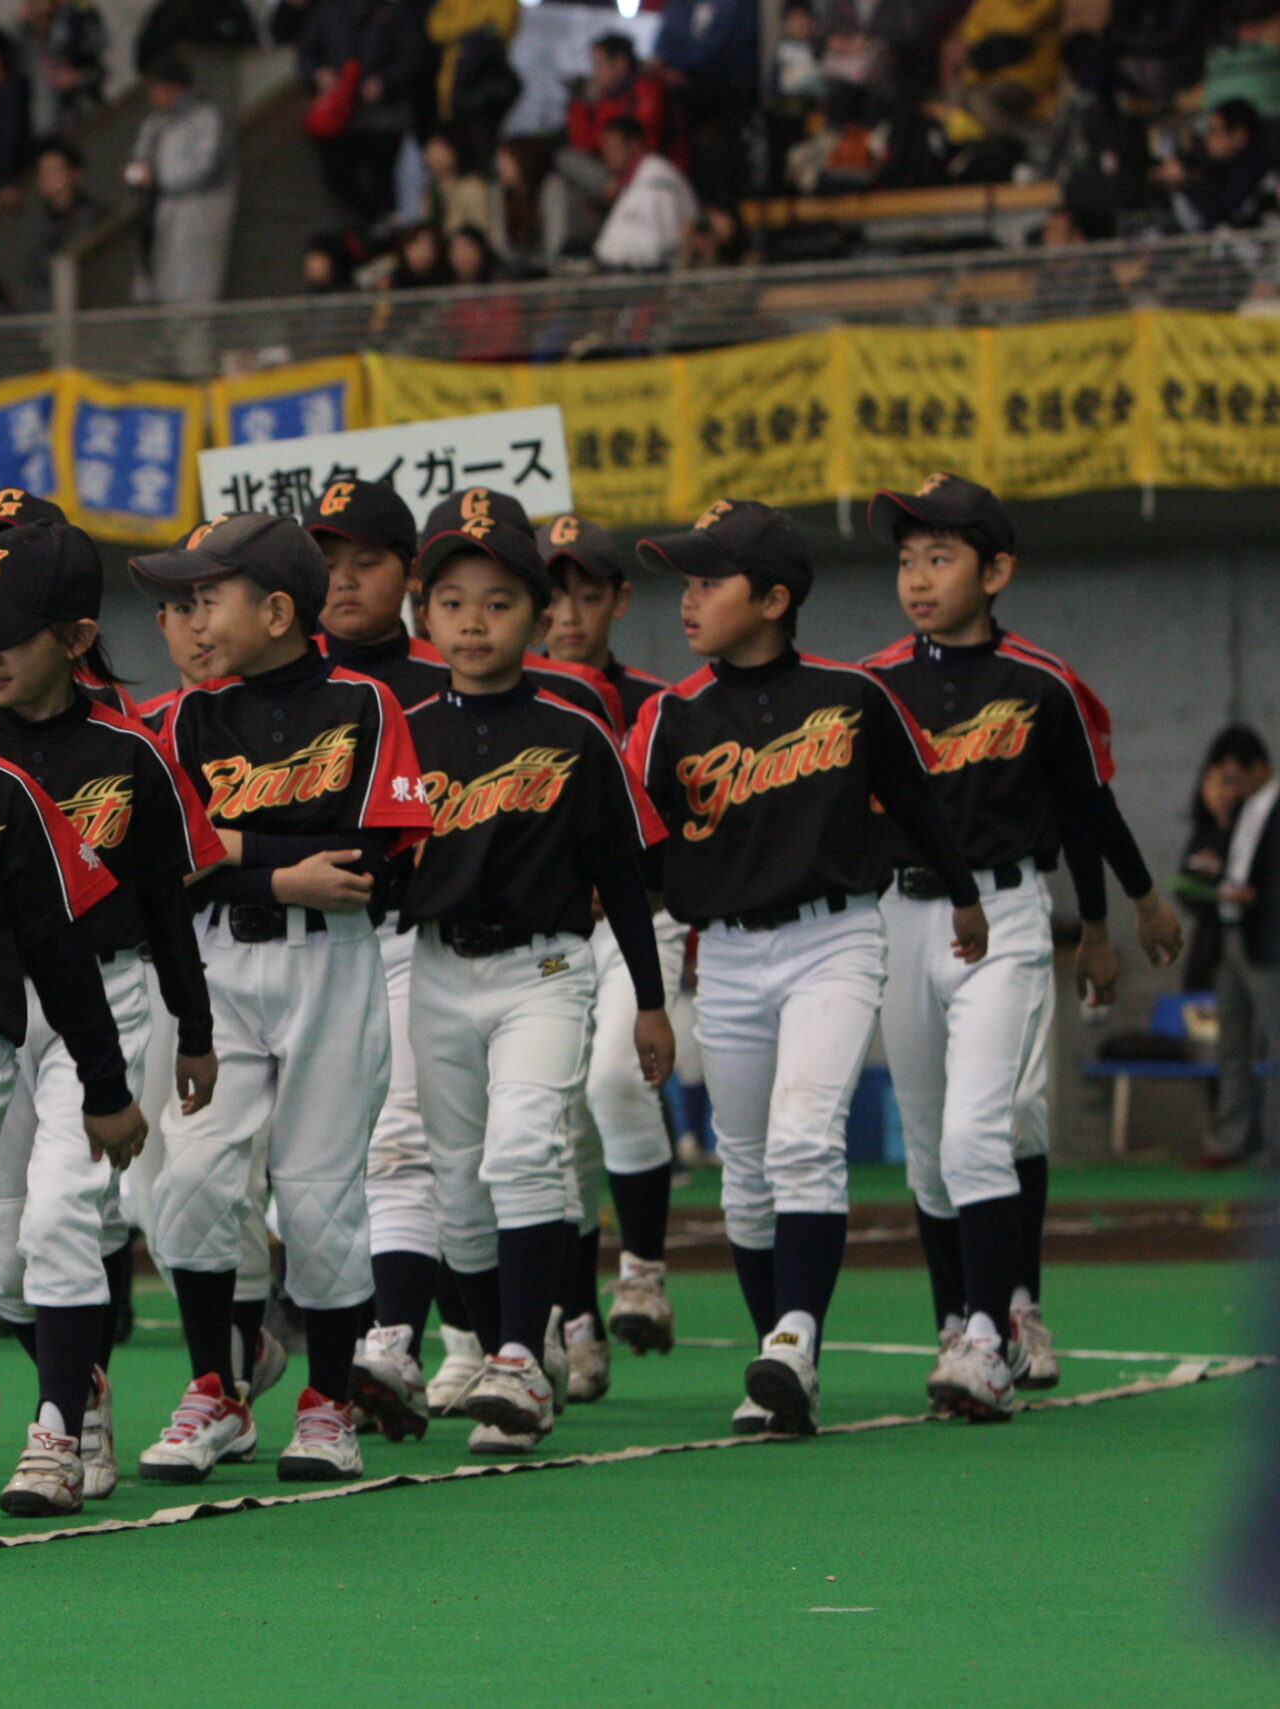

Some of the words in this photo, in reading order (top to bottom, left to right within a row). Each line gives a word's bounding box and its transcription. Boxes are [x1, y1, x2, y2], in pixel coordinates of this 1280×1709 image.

[320, 481, 355, 516] G
[460, 487, 491, 520] G
[550, 515, 580, 546] G
[677, 704, 863, 842] Giants
